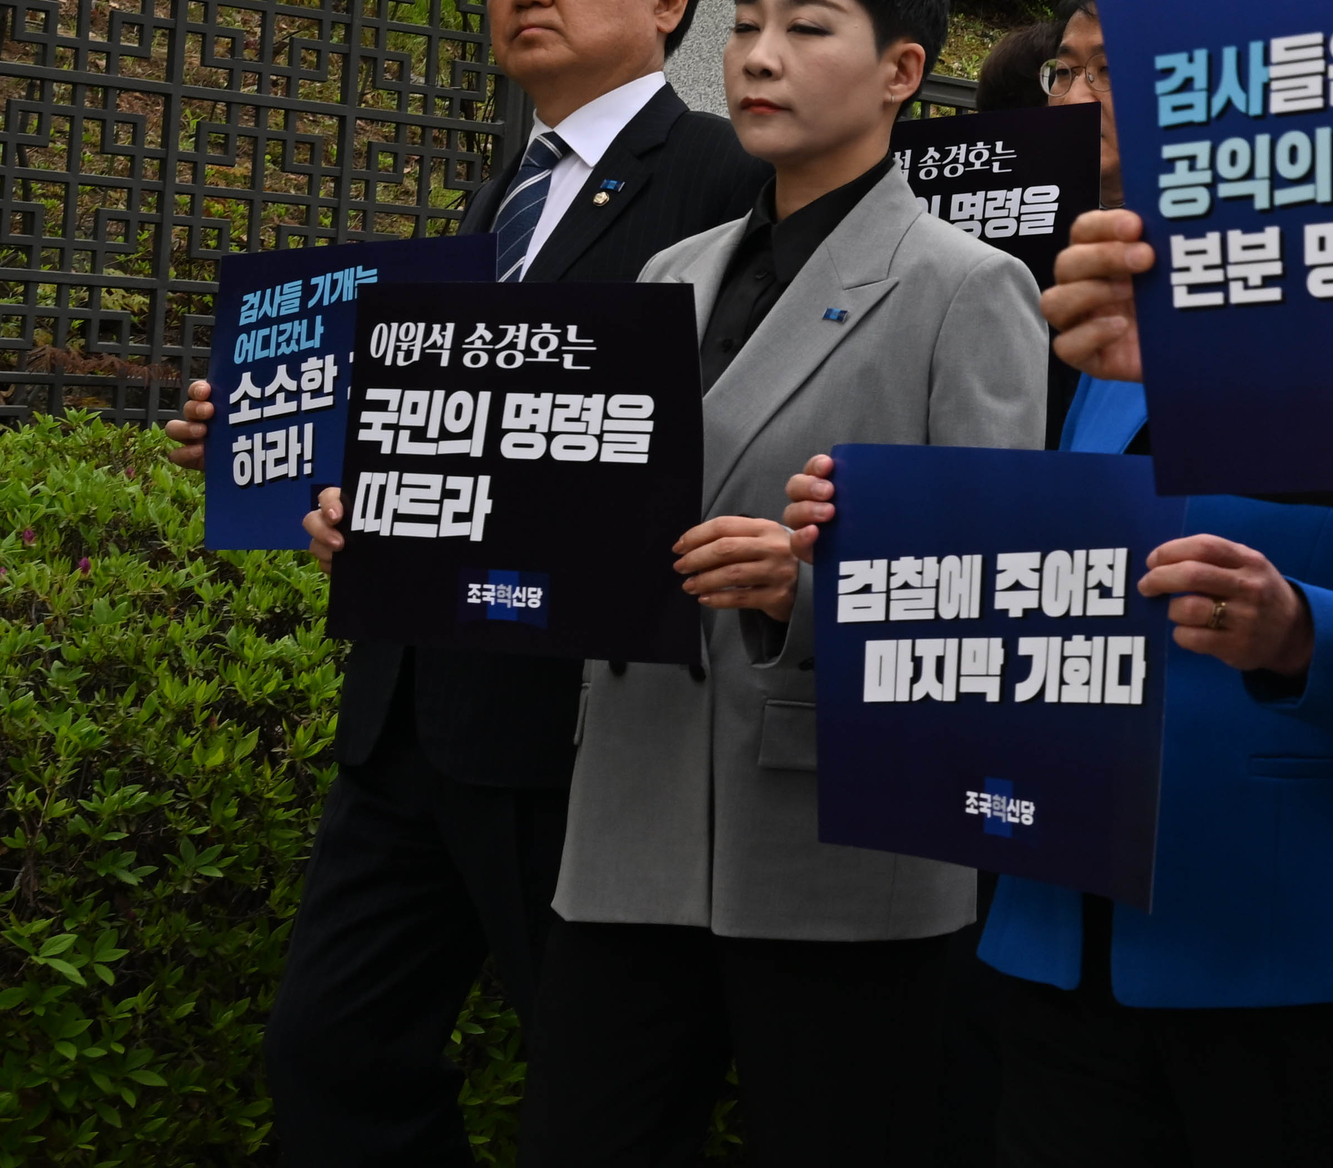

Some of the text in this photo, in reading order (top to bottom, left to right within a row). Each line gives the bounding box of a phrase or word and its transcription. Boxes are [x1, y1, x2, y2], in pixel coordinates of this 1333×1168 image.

[918, 141, 1017, 180] 송경호는
[1157, 126, 1333, 219] 공익의
[950, 184, 1060, 239] 명령을
[239, 265, 378, 326] 검사들 기개는
[1169, 225, 1284, 309] 본분
[233, 316, 324, 365] 어디갔나
[370, 322, 597, 370] 이원석 송경호는
[228, 354, 338, 425] 소소한
[231, 423, 314, 486] 하라!
[358, 388, 656, 464] 국민의 명령을
[350, 471, 492, 542] 따르라
[467, 583, 543, 609] 조국혁신당
[837, 548, 1128, 623] 검찰에 주어진
[863, 636, 1146, 705] 마지막 기회다
[964, 791, 1036, 825] 조국혁신당
